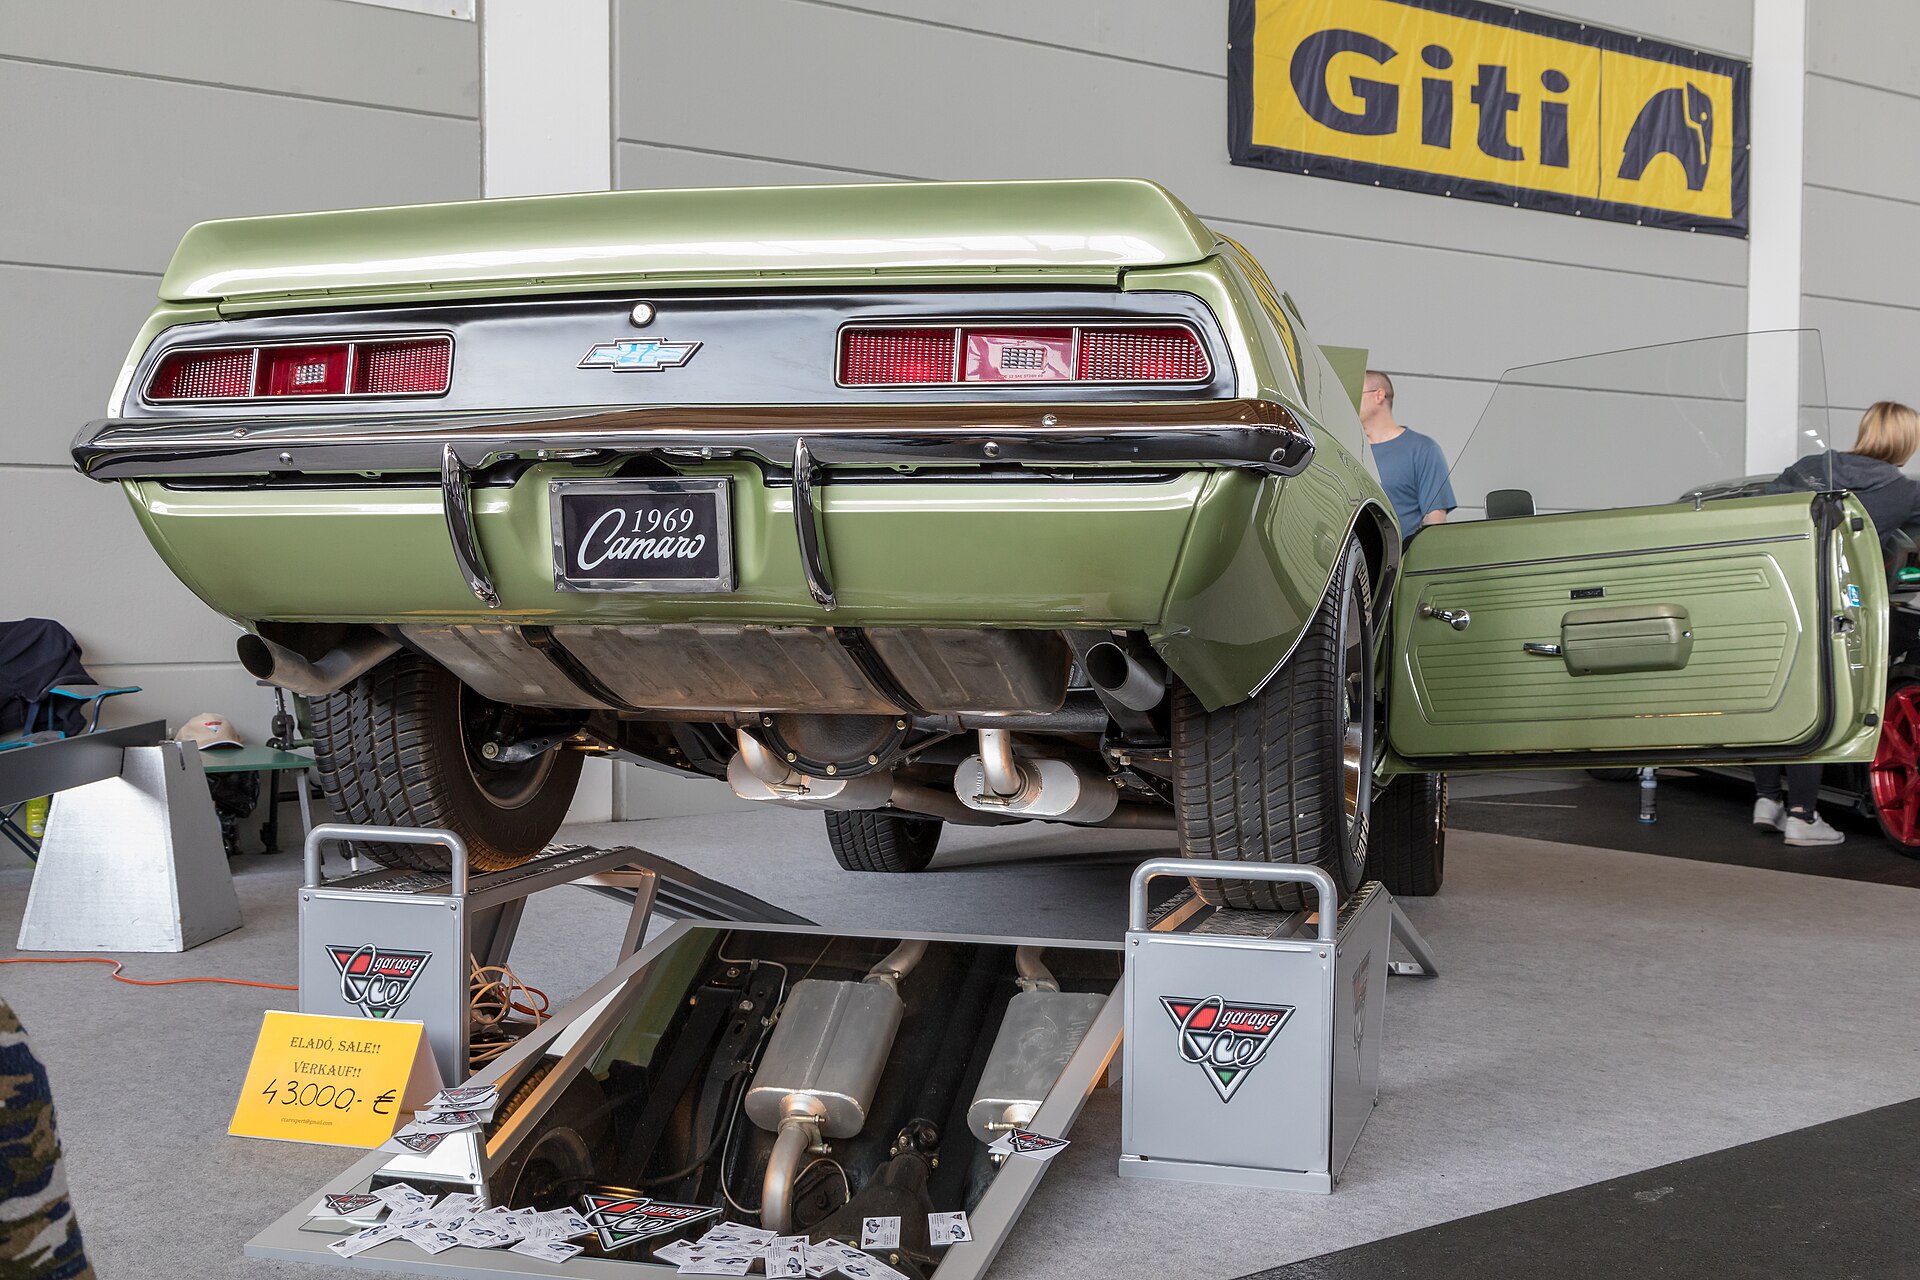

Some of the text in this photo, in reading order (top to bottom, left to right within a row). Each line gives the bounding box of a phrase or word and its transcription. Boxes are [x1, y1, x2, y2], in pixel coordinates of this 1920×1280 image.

[1289, 28, 1570, 168] Giti
[631, 507, 695, 534] 1969
[577, 508, 706, 571] Camaro
[372, 956, 419, 974] garage
[1219, 1009, 1279, 1030] garage
[289, 1036, 381, 1054] ELADÓ, SALE!!
[293, 1061, 362, 1078] VERKAUF!!
[373, 1088, 397, 1115] €
[639, 1205, 702, 1218] garage
